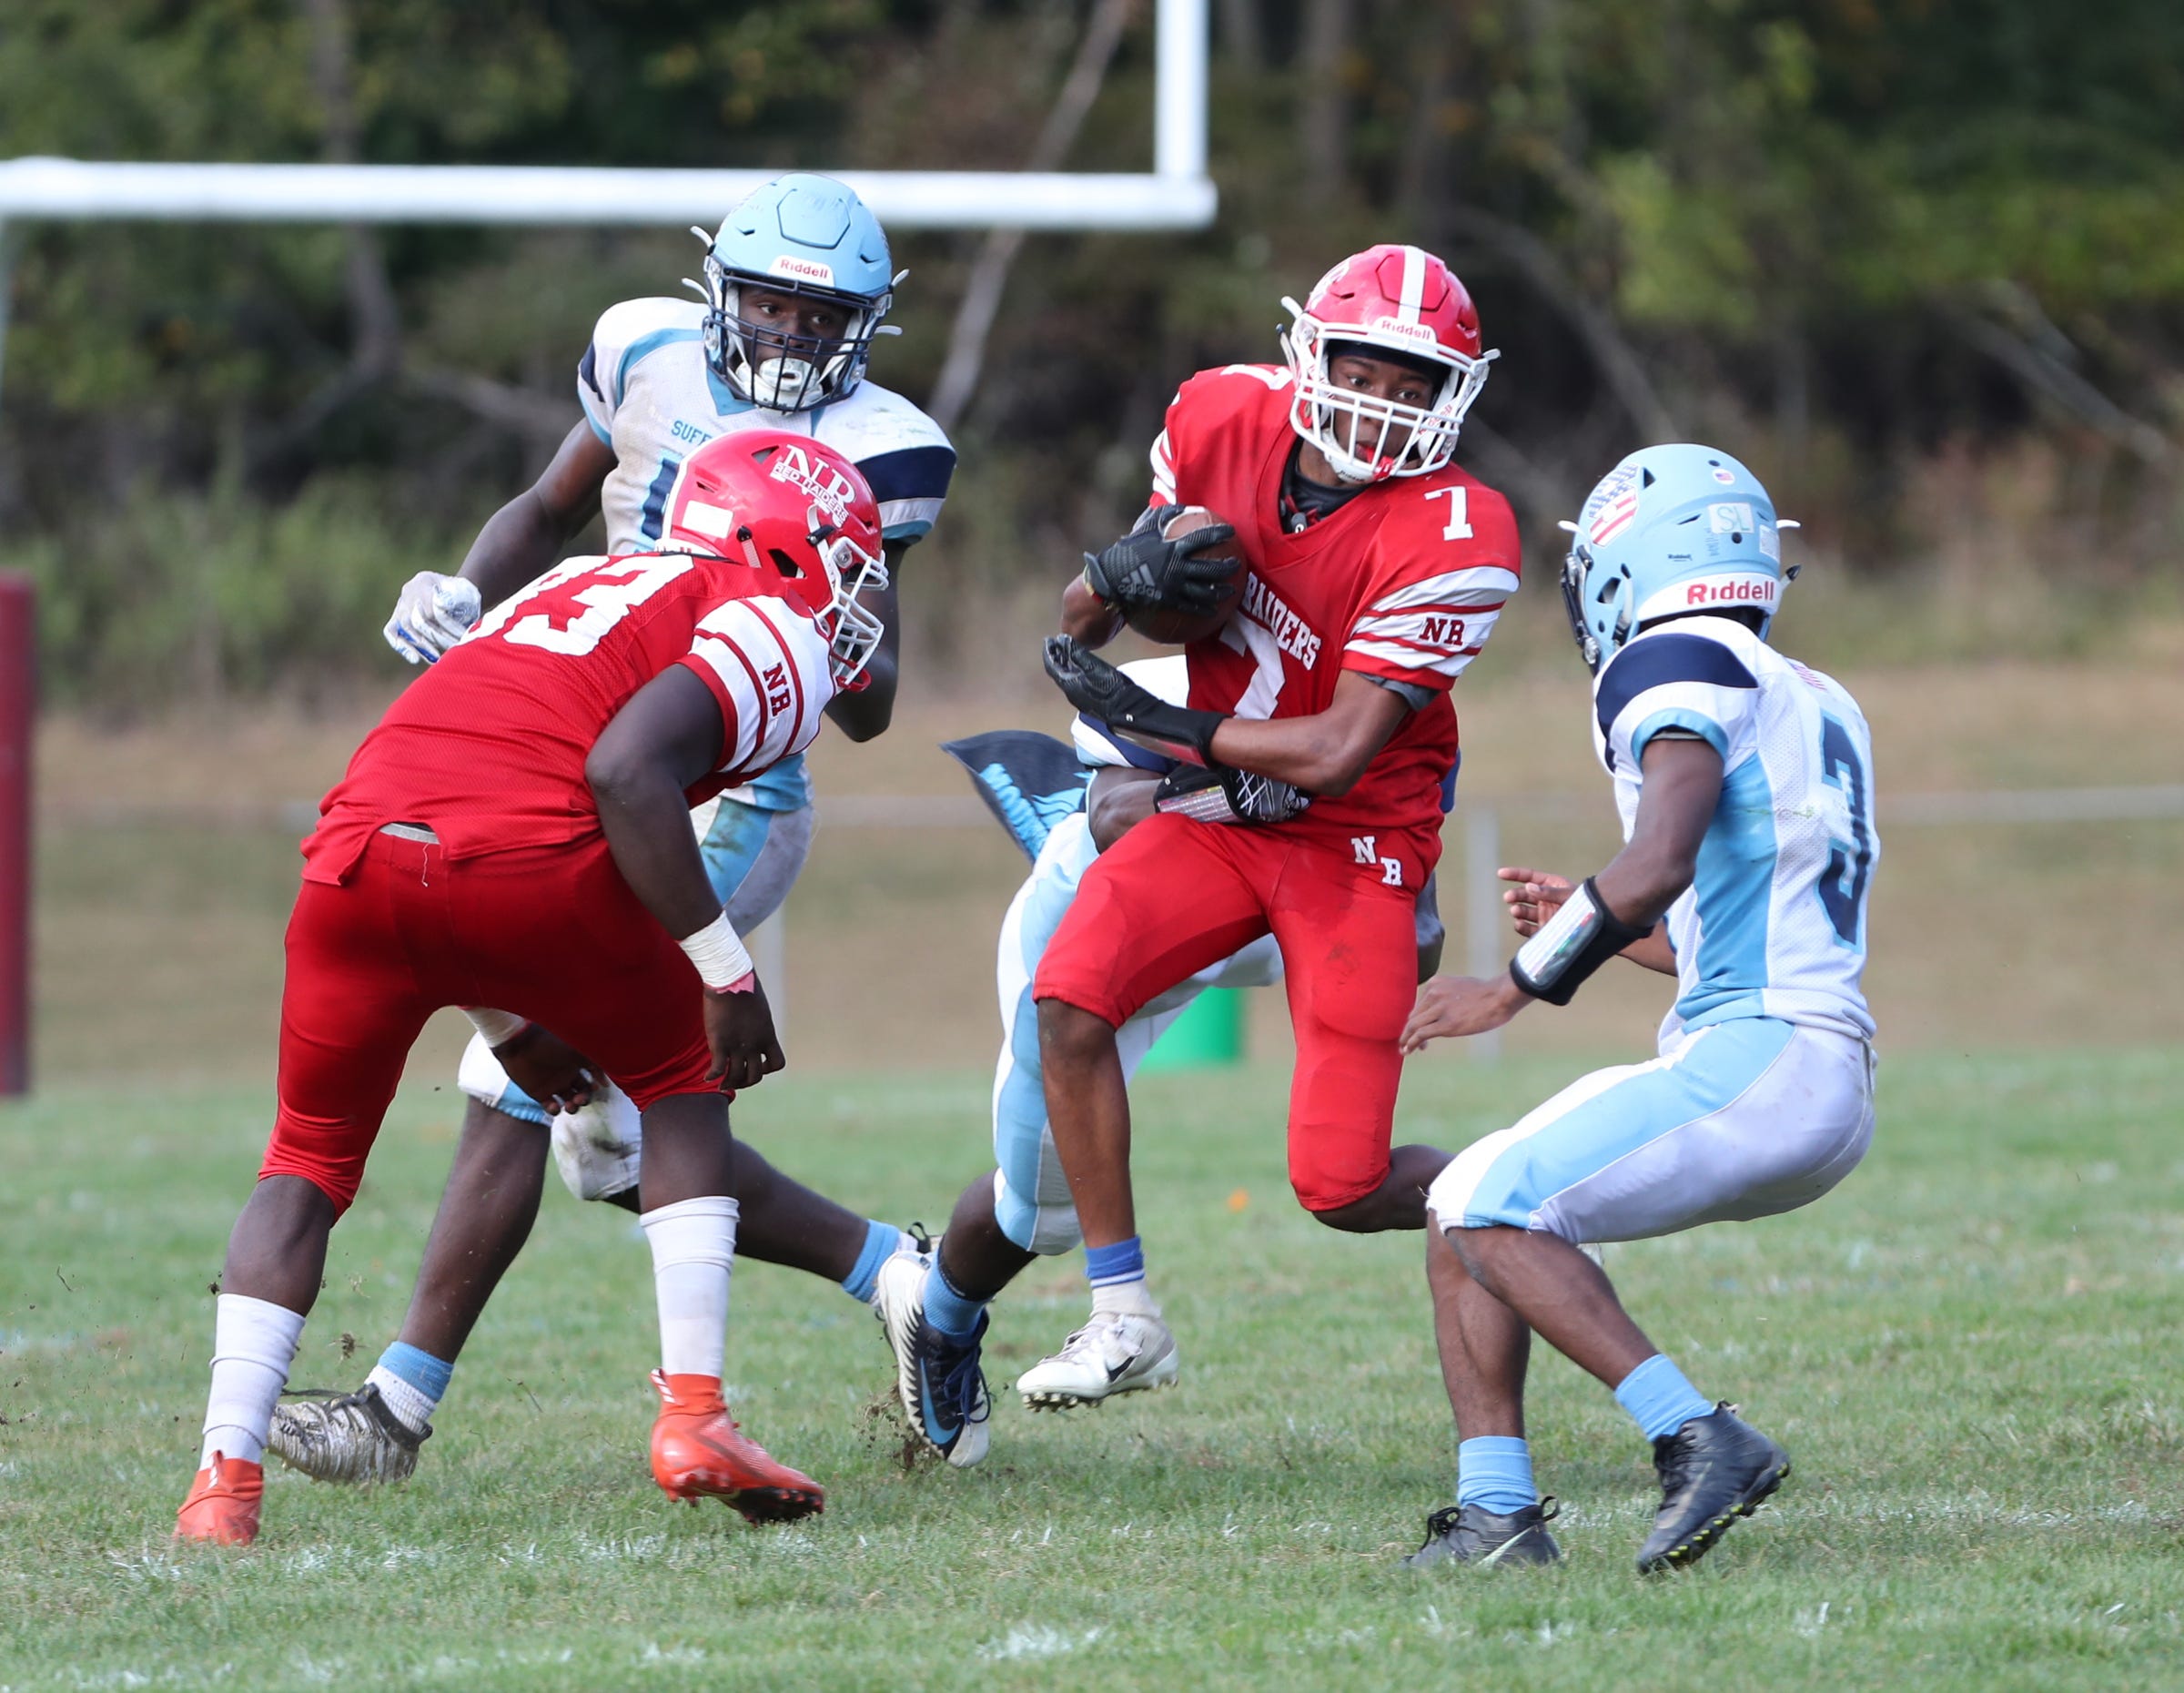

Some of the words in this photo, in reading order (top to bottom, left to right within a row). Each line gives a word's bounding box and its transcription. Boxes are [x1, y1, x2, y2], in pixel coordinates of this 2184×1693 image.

[780, 259, 828, 279] Riddell
[1381, 319, 1431, 340] Riddell
[802, 476, 850, 525] RAIDERS
[1423, 485, 1474, 542] 7
[1686, 580, 1775, 605] Riddell
[1240, 571, 1322, 672] RAIDERS
[1815, 706, 1871, 955] 3
